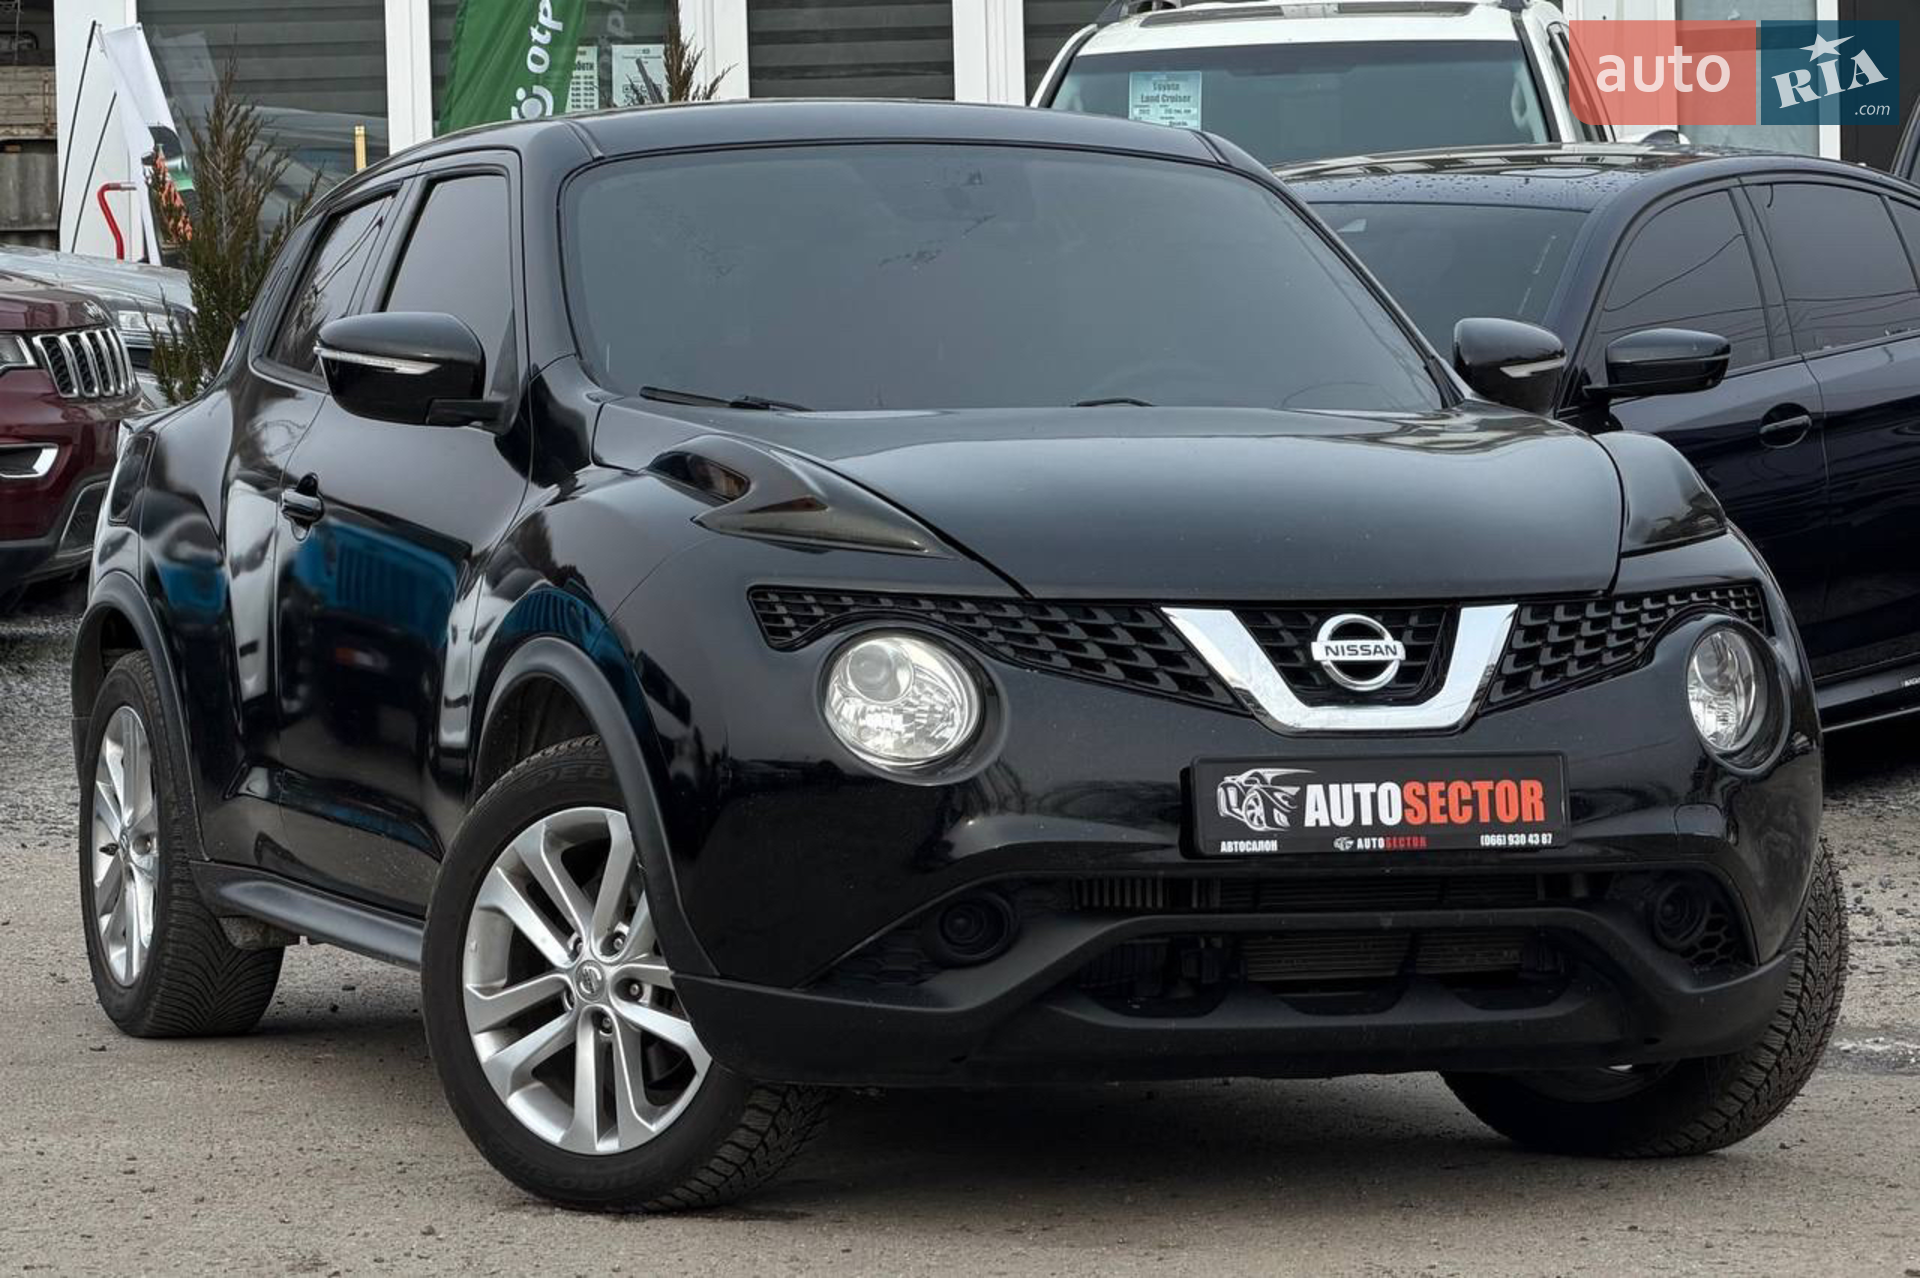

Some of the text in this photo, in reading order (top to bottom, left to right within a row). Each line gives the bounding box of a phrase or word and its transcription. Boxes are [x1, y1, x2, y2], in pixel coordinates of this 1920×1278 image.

[1152, 82, 1180, 92] Toyota
[1141, 93, 1191, 103] Land Cruiser
[1324, 644, 1398, 656] NISSAN
[1304, 779, 1545, 828] AUTOSECTOR
[1220, 839, 1278, 853] АВТОСАЛОН
[1357, 836, 1427, 850] AUTOSECTOR
[1480, 834, 1506, 847] (066)
[1507, 833, 1526, 846] 930
[1528, 833, 1540, 845] 43
